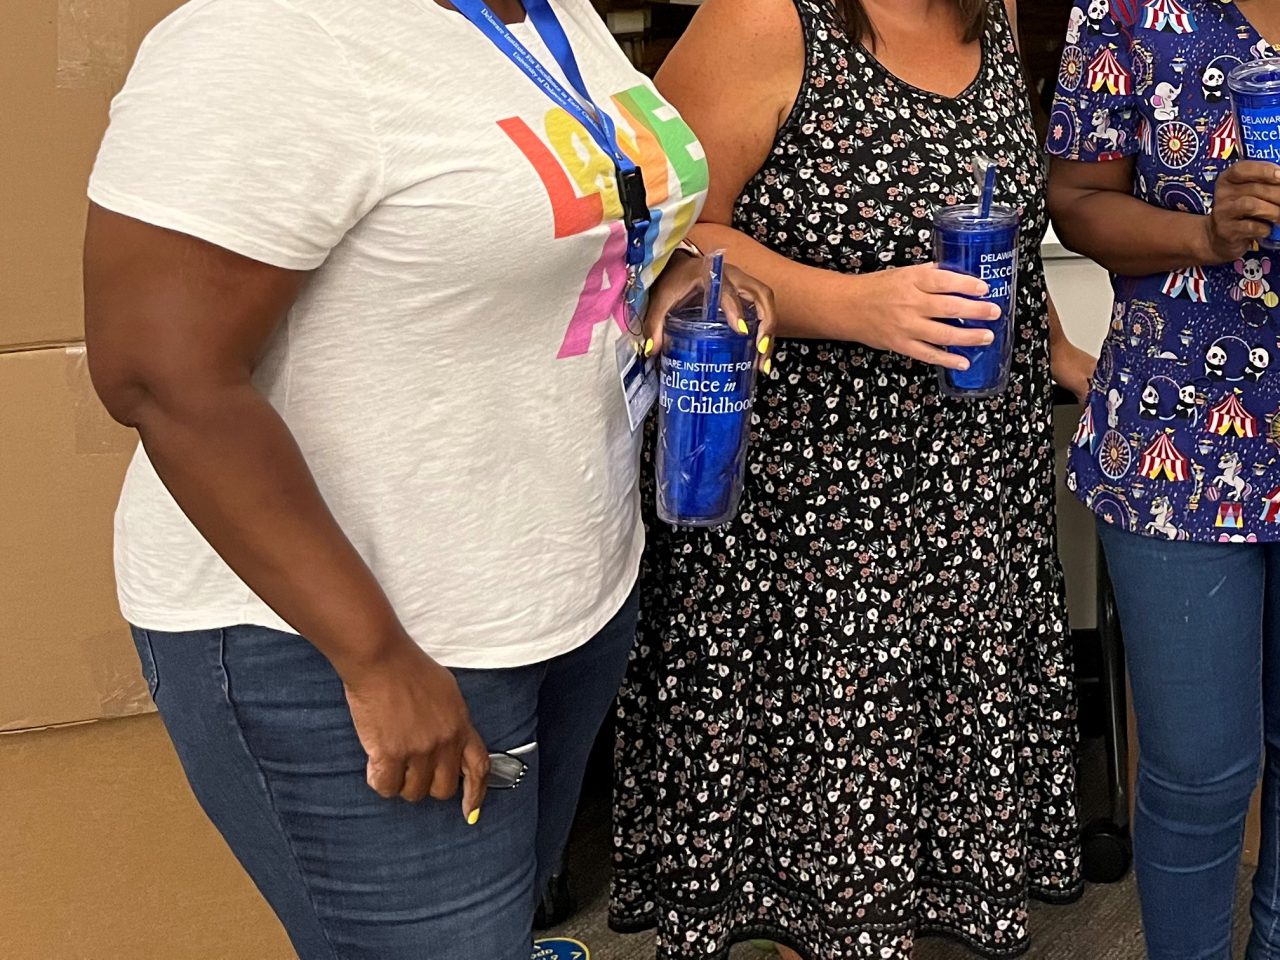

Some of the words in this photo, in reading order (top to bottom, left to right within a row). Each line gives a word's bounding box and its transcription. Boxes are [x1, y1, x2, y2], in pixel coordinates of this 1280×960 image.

[684, 361, 734, 373] INSTITUTE
[736, 361, 752, 372] FOR
[724, 379, 736, 392] in
